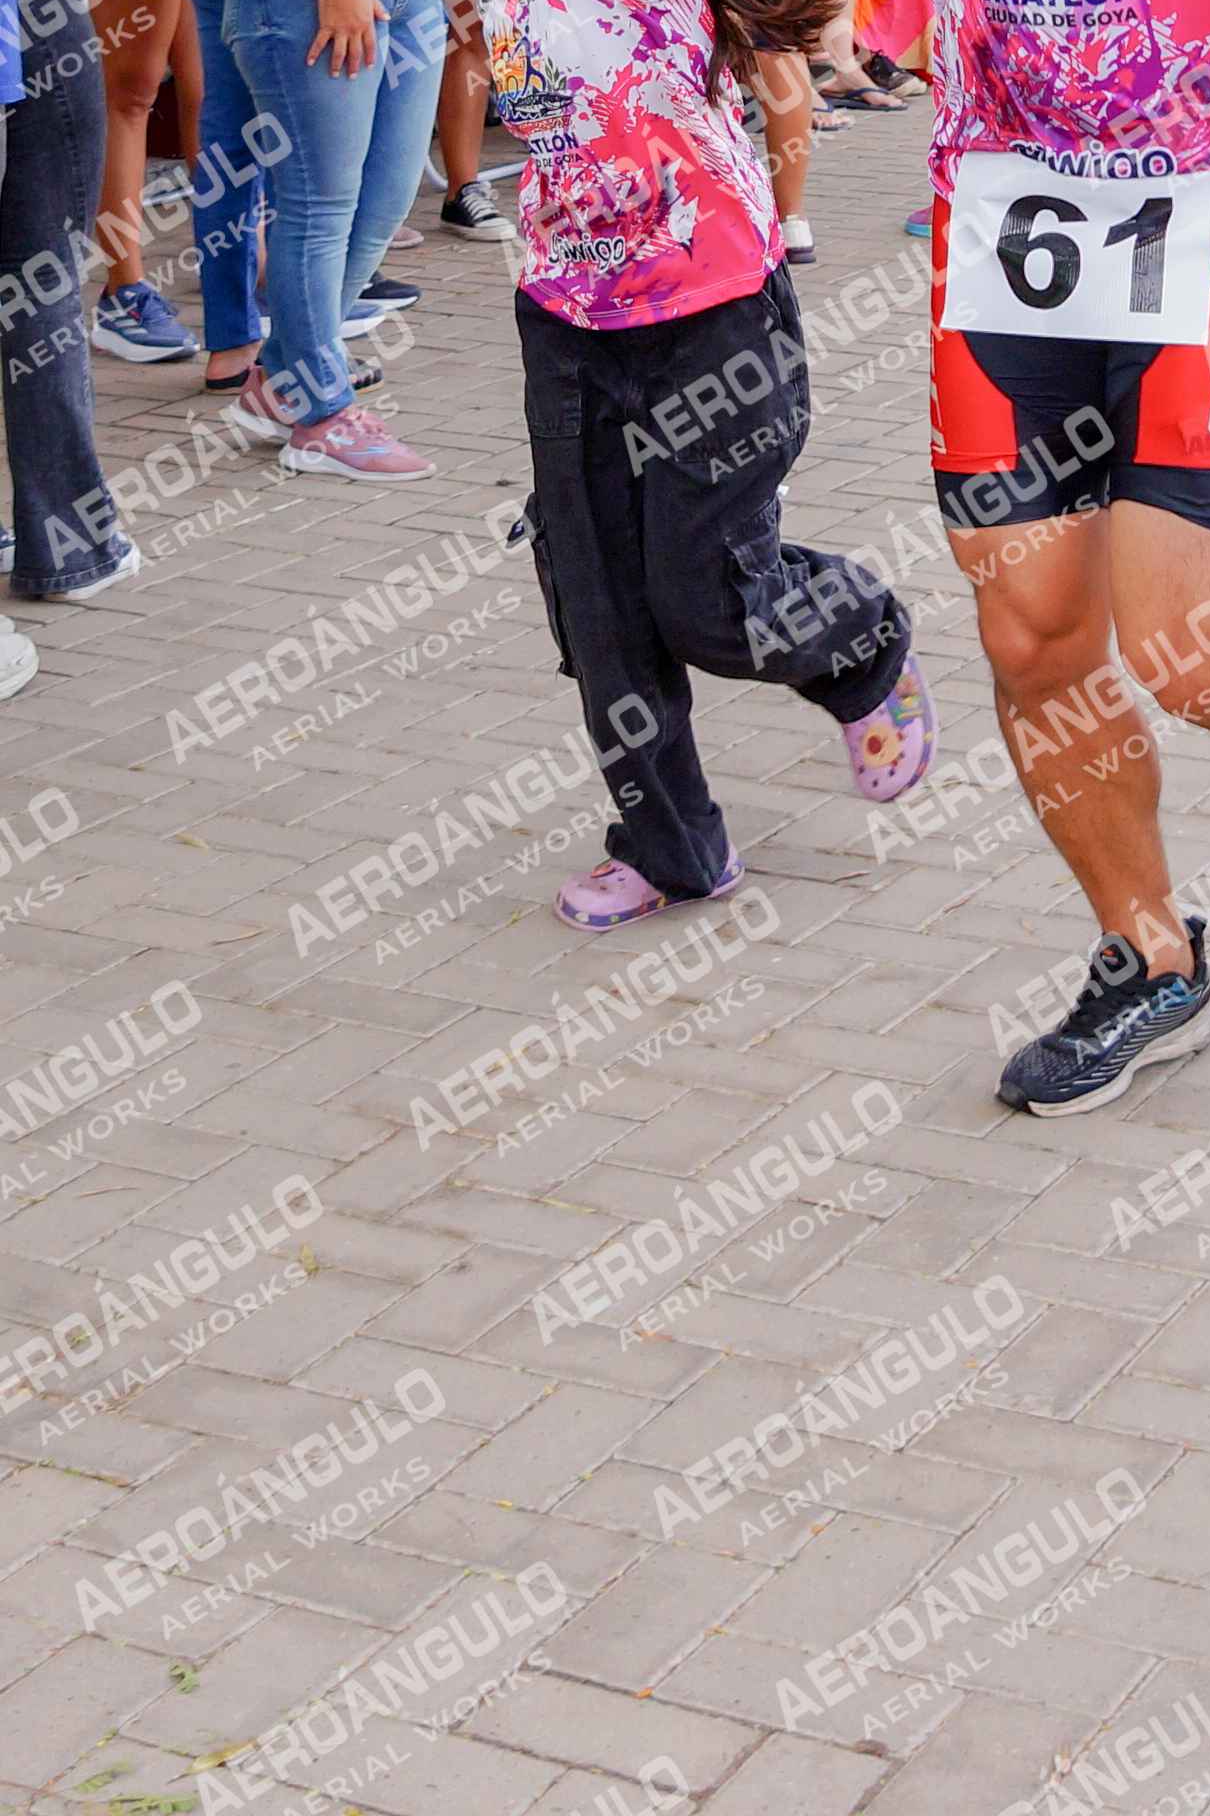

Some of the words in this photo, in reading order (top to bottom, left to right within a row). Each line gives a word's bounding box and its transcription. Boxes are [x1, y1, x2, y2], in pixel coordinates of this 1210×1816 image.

[1052, 13, 1076, 28] DE
[1083, 7, 1138, 27] GOYA
[528, 129, 580, 155] ATLÓN
[996, 194, 1174, 316] 61
